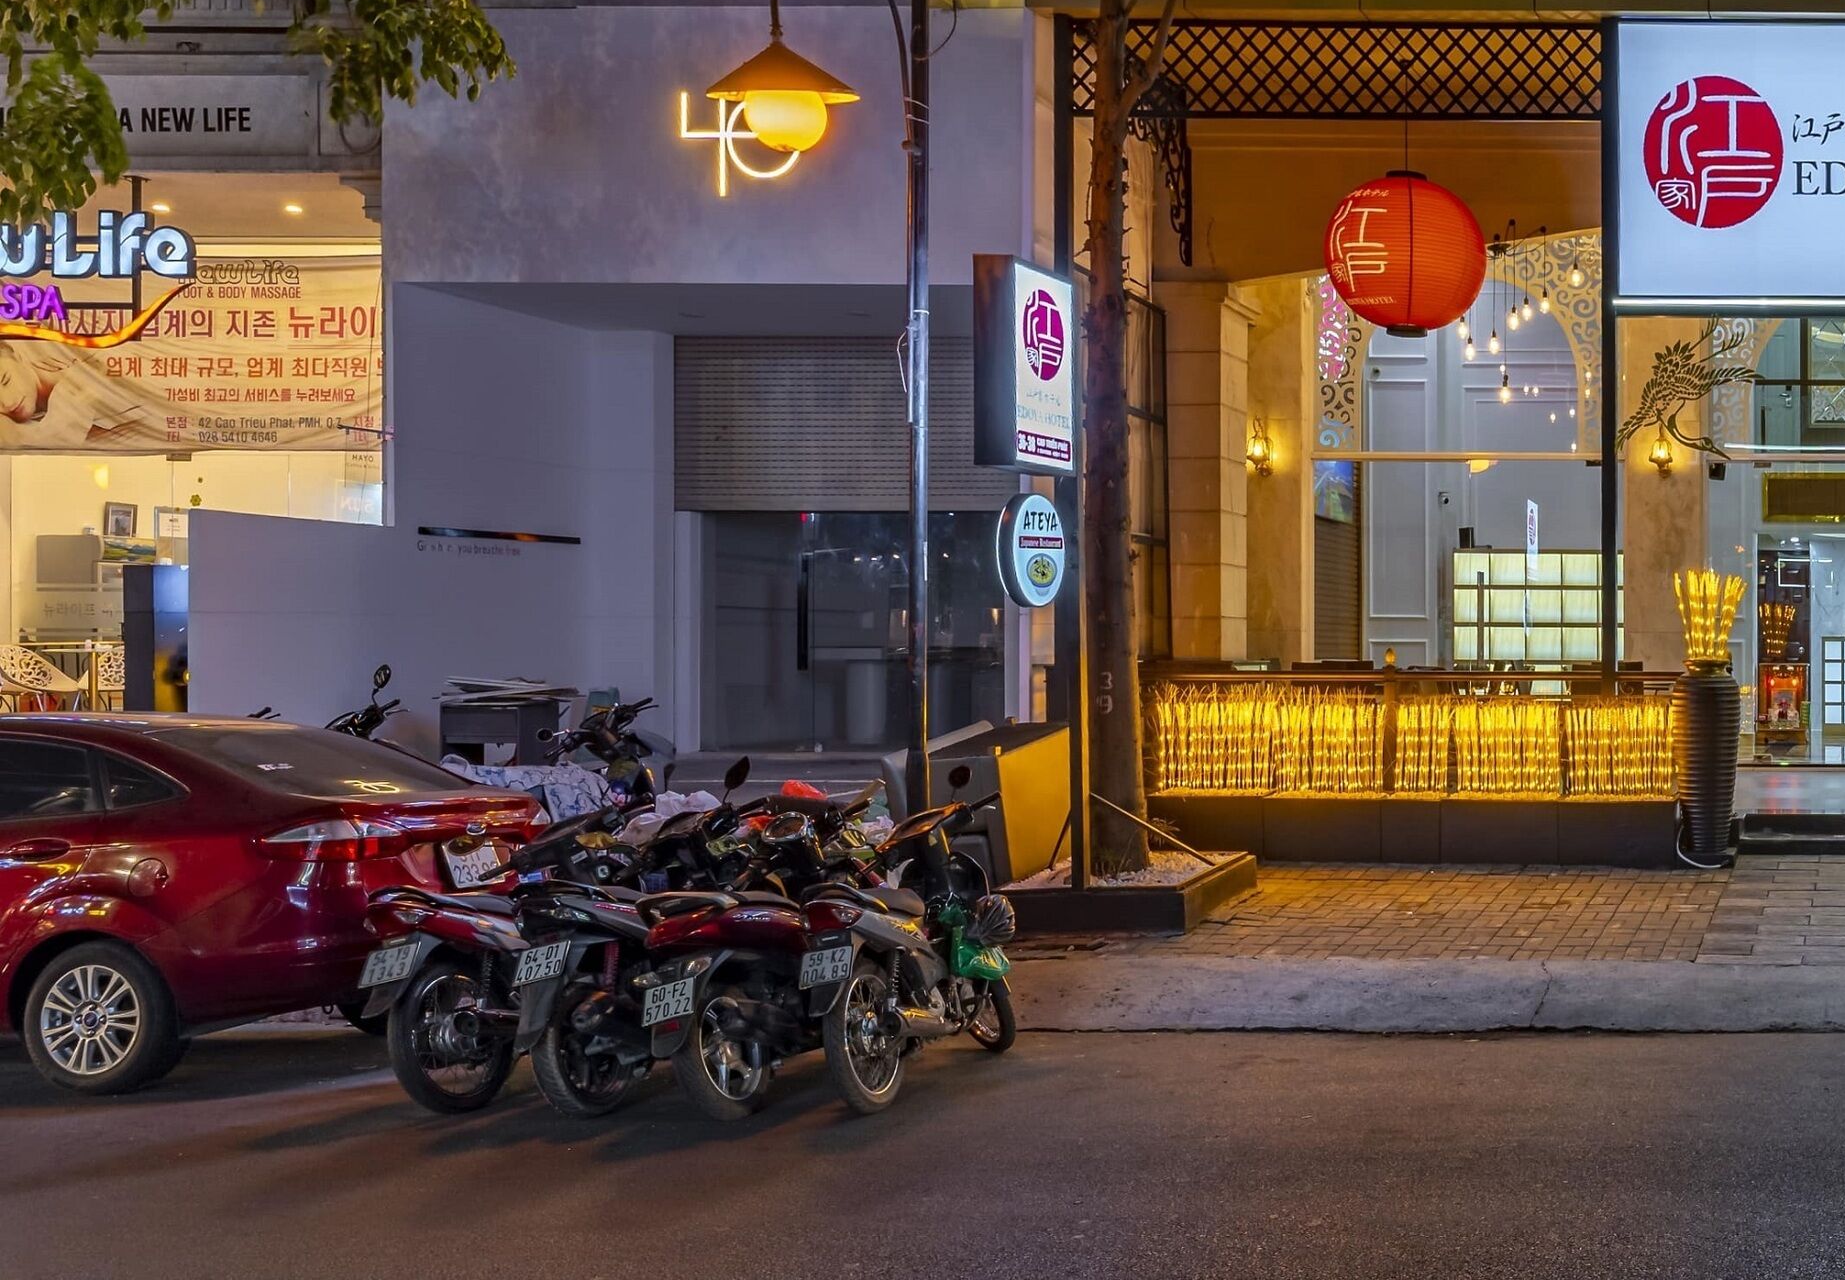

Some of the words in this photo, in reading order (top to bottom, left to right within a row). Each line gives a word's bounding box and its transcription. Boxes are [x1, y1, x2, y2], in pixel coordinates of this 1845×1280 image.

[141, 107, 194, 132] NEW
[203, 107, 251, 132] LIFE
[0, 283, 67, 320] SPA
[218, 286, 247, 298] BODY
[251, 286, 301, 298] MASSAGE
[226, 309, 275, 337] 지존
[106, 357, 142, 377] 업계
[151, 357, 188, 378] 최대
[247, 357, 283, 378] 업계
[292, 357, 368, 378] 최다직원
[166, 388, 200, 403] 가성비
[204, 389, 240, 403] 최고의
[244, 388, 291, 403] 서비스를
[296, 388, 356, 403] 누려보세요
[199, 416, 212, 429] 42
[215, 417, 236, 429] Cao
[1023, 510, 1058, 531] ATEYA
[525, 944, 559, 964] 64-D1
[808, 948, 846, 967] 59-K2
[516, 959, 561, 982] 407.50
[651, 981, 687, 1002] 60-F2
[645, 997, 691, 1023] 570.22
